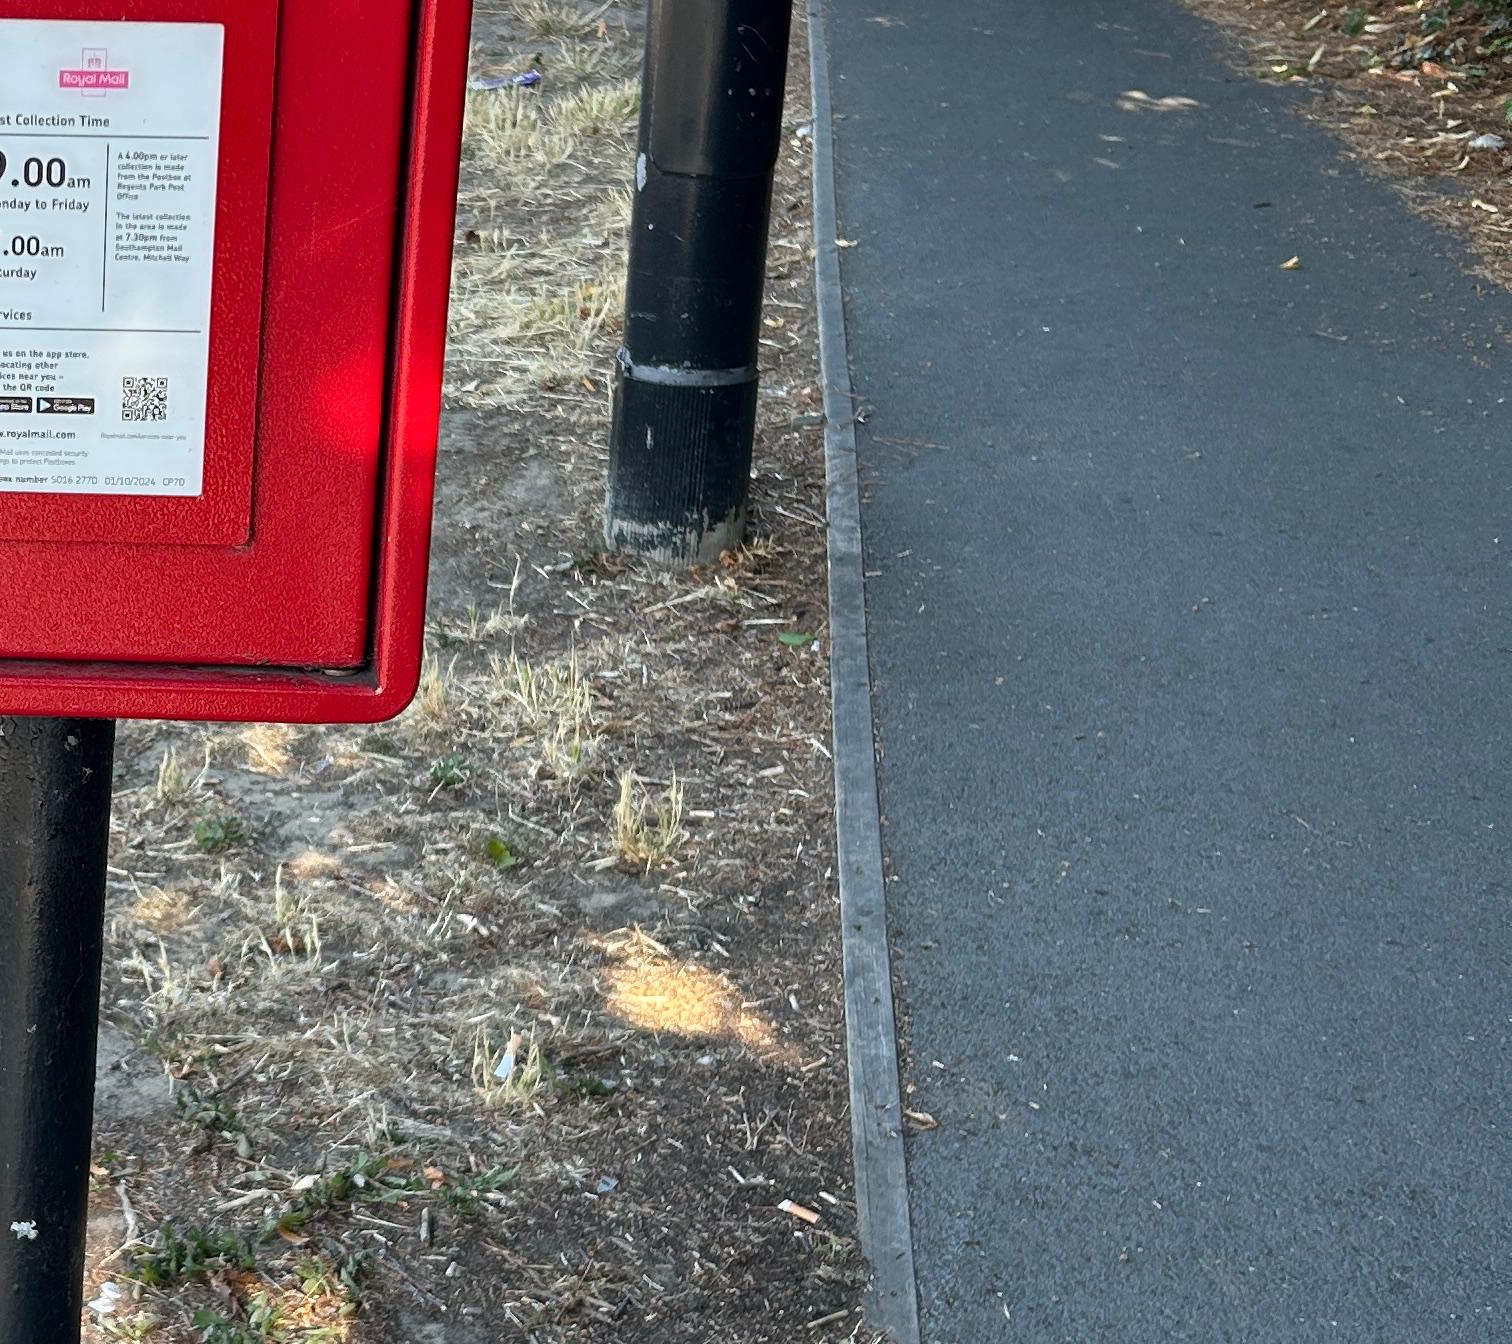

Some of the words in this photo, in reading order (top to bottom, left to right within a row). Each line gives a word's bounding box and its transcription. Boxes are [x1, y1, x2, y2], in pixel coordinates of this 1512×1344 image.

[63, 72, 97, 87] Royal
[98, 72, 126, 85] Mail
[15, 113, 75, 127] Collection
[78, 114, 110, 128] Time
[118, 152, 123, 160] A
[125, 151, 158, 161] 4.00pm
[117, 162, 153, 171] collection
[163, 163, 185, 172] made
[117, 172, 136, 181] from
[137, 172, 150, 181] the
[149, 182, 166, 191] Park
[168, 182, 185, 191] Post
[35, 198, 47, 211] to
[52, 198, 90, 213] Friday
[116, 211, 130, 220] The
[155, 212, 191, 222] collection
[125, 222, 137, 230] the
[166, 223, 187, 231] made
[125, 232, 158, 243] 7.30pm
[159, 233, 178, 242] from
[166, 243, 183, 252] Mail
[2, 349, 13, 358] us
[15, 349, 27, 358] on
[29, 348, 44, 358] the
[46, 350, 62, 360] app
[64, 350, 90, 359] store.
[34, 360, 59, 370] other
[18, 373, 39, 381] near
[40, 374, 57, 383] you
[3, 383, 17, 392] the
[19, 383, 32, 392] QR
[35, 383, 55, 393] code
[15, 474, 48, 484] number
[104, 476, 156, 487] 01/10/2024
